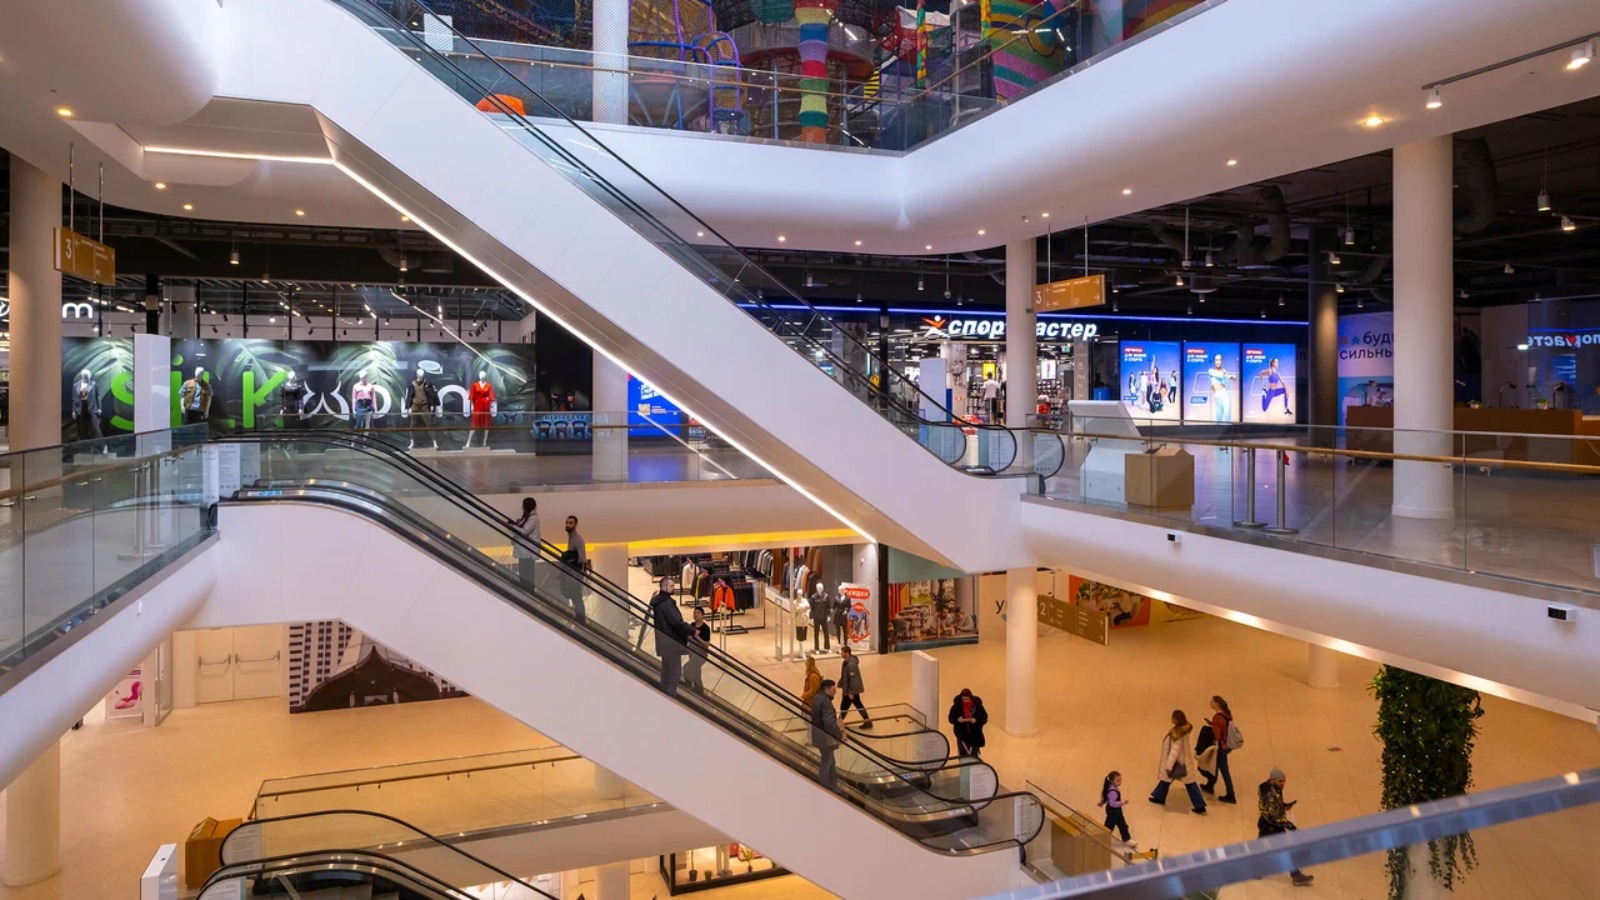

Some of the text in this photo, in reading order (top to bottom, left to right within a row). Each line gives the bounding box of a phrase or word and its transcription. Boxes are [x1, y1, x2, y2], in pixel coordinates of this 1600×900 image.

[65, 239, 72, 259] 3
[1035, 290, 1042, 305] 3
[948, 318, 1098, 341] спорастер
[1363, 331, 1394, 347] буд
[1039, 601, 1047, 616] 2
